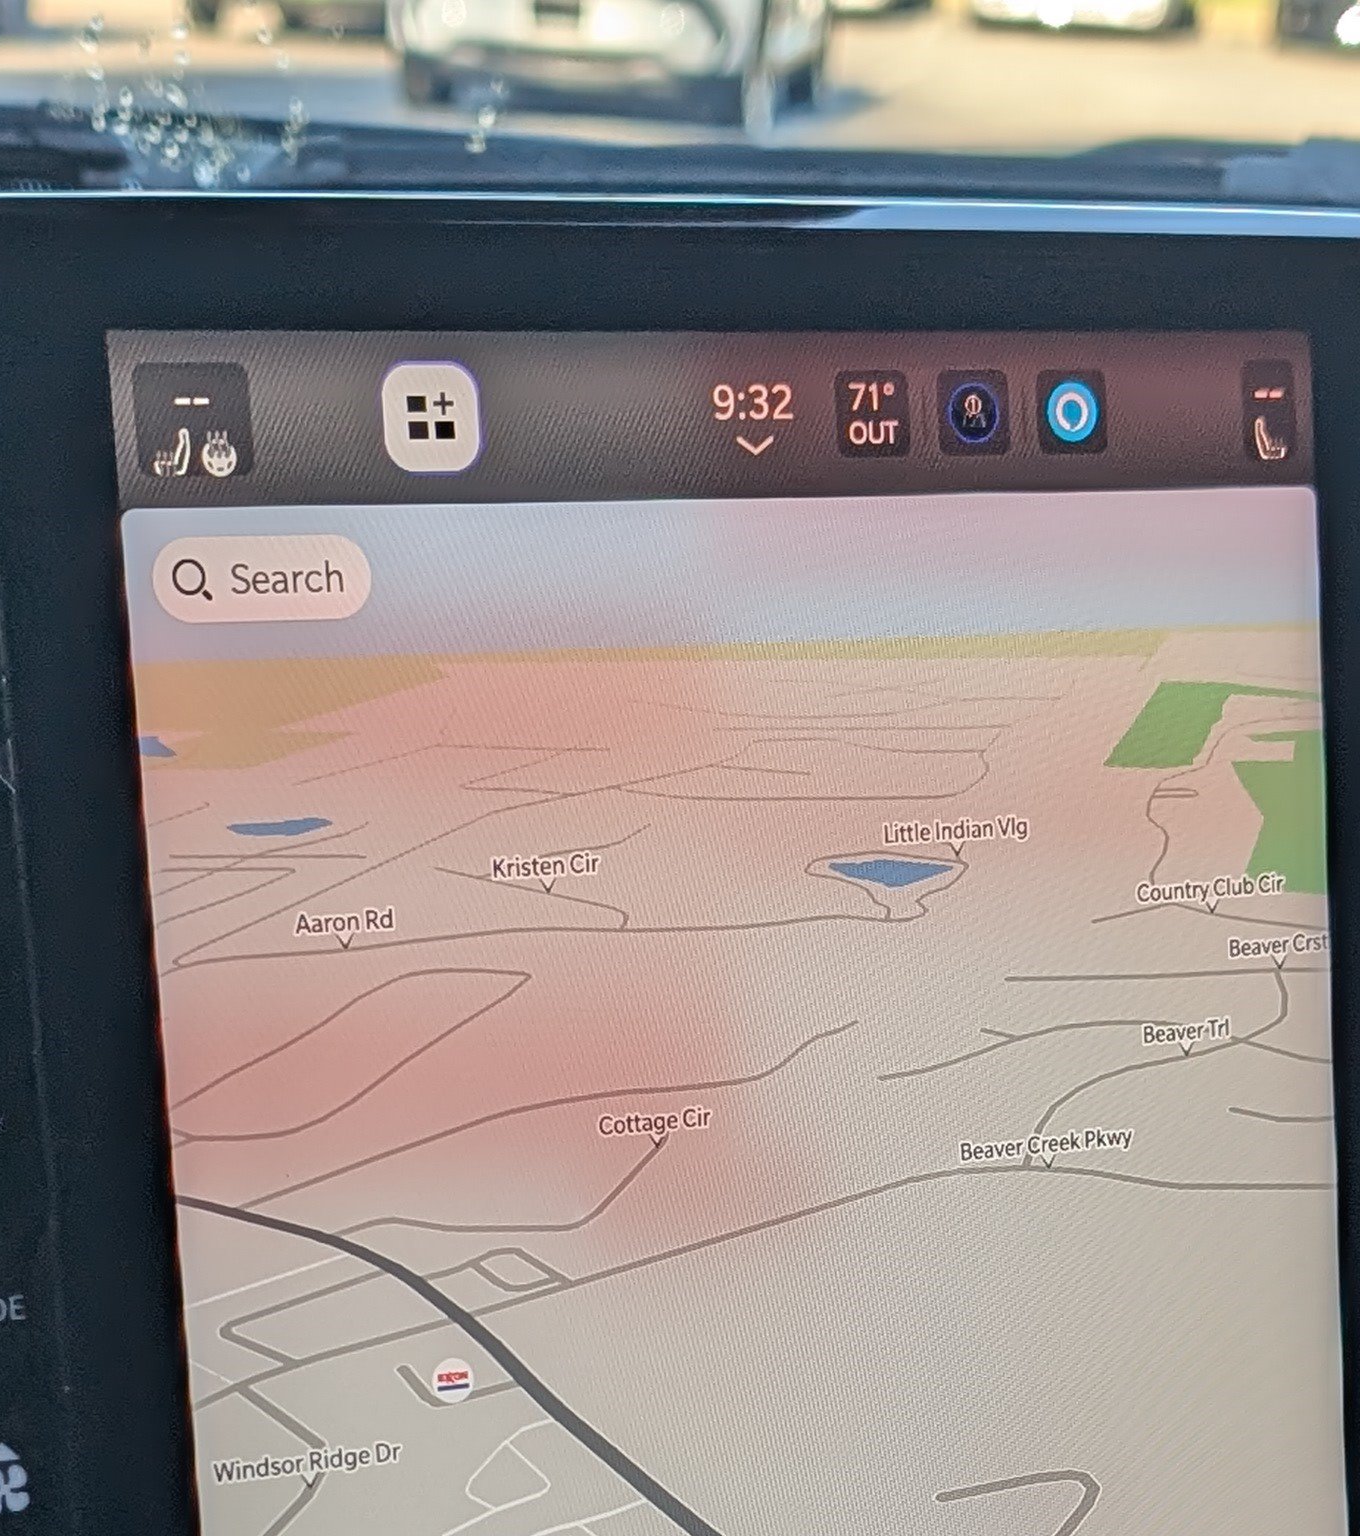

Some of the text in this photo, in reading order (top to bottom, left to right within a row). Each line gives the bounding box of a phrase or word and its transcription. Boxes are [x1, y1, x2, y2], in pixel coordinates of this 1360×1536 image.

[713, 384, 794, 421] 9:32
[848, 382, 896, 412] 71°
[849, 420, 899, 445] OUT
[231, 559, 345, 595] Search
[884, 817, 1028, 845] Little Indian Vlg
[492, 853, 600, 878] Kristen Cir
[1137, 875, 1284, 904] Country Club Cir
[295, 909, 394, 934] Aaron Rd
[1229, 937, 1288, 957] Beaver
[1143, 1019, 1230, 1045] Beaver Trl
[598, 1108, 712, 1141] Cottage Cir
[960, 1129, 1133, 1162] Beaver Creek Pkwy
[213, 1441, 401, 1484] Windsor Ridge Dr
